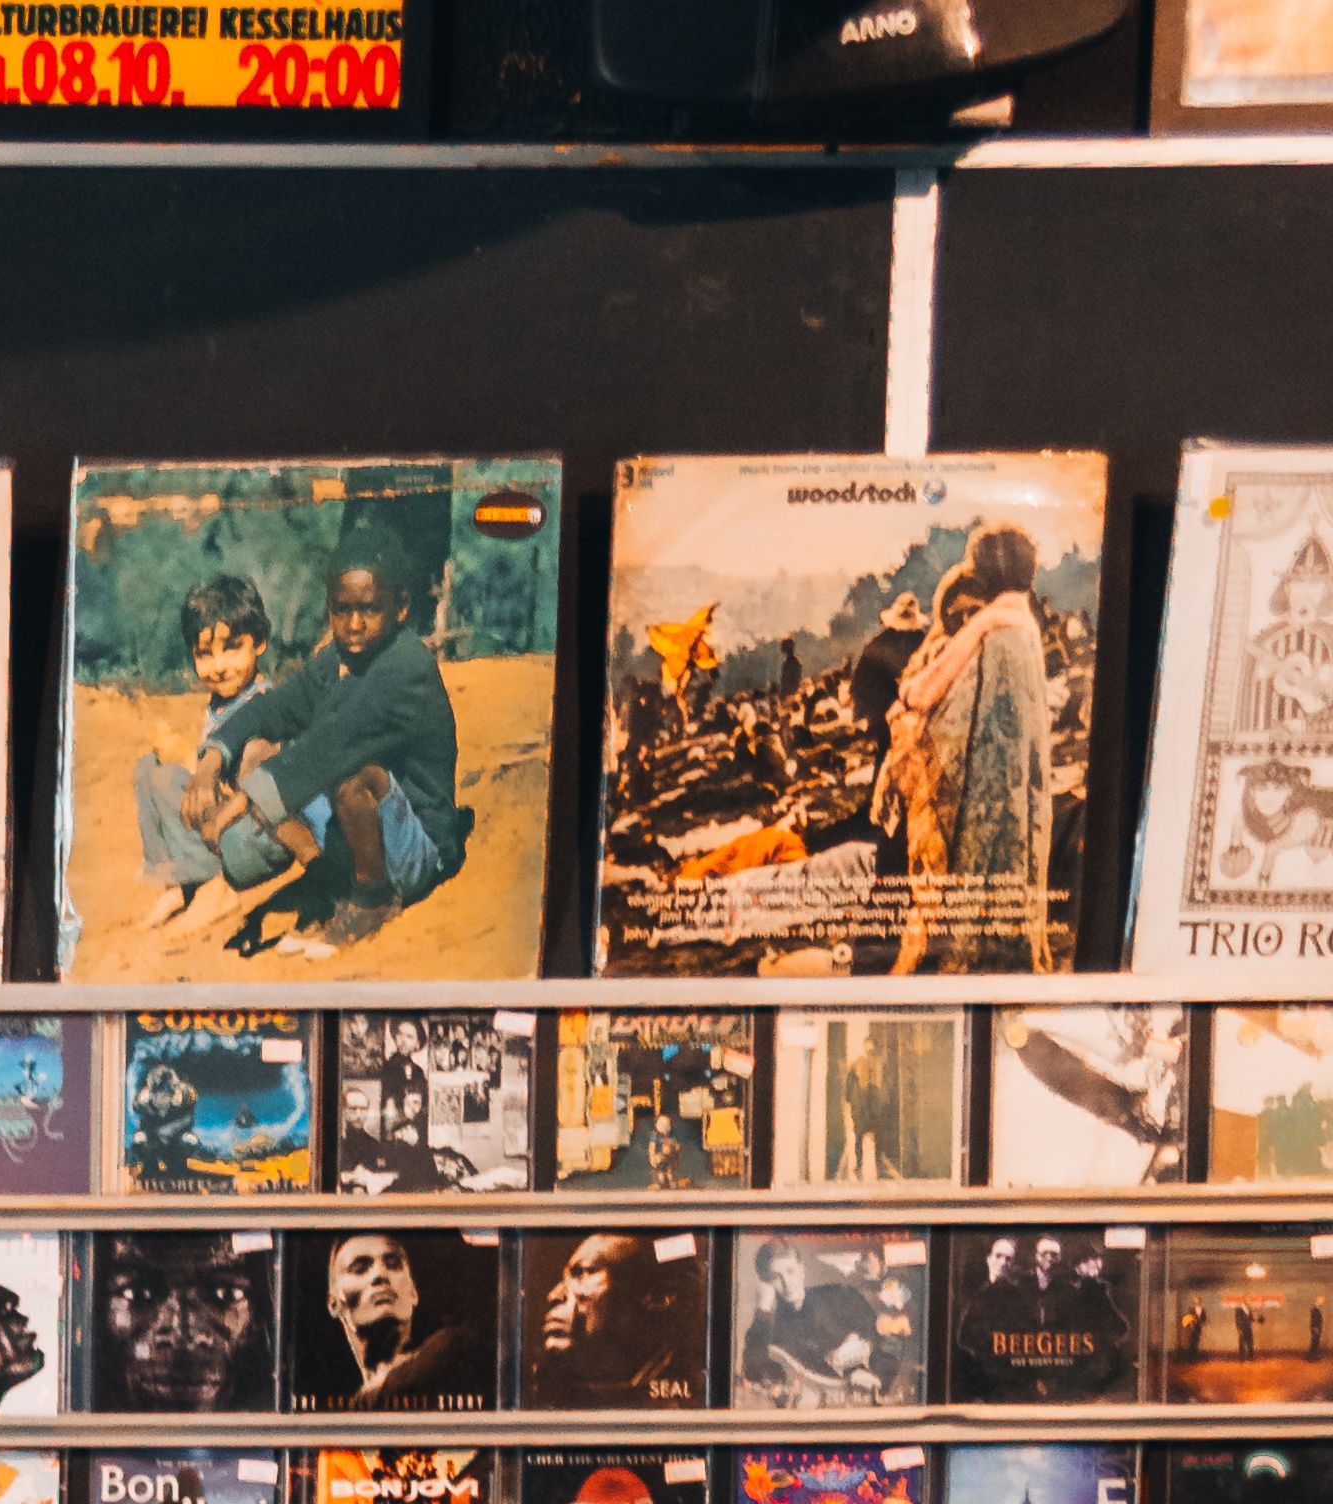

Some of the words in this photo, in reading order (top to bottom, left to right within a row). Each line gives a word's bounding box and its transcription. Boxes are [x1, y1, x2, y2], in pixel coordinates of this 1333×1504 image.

[220, 6, 404, 42] KESSELHAUS
[237, 42, 400, 108] 20:00
[1179, 919, 1284, 957] TRIO
[649, 1380, 694, 1399] SEAL
[331, 1478, 402, 1499] BON
